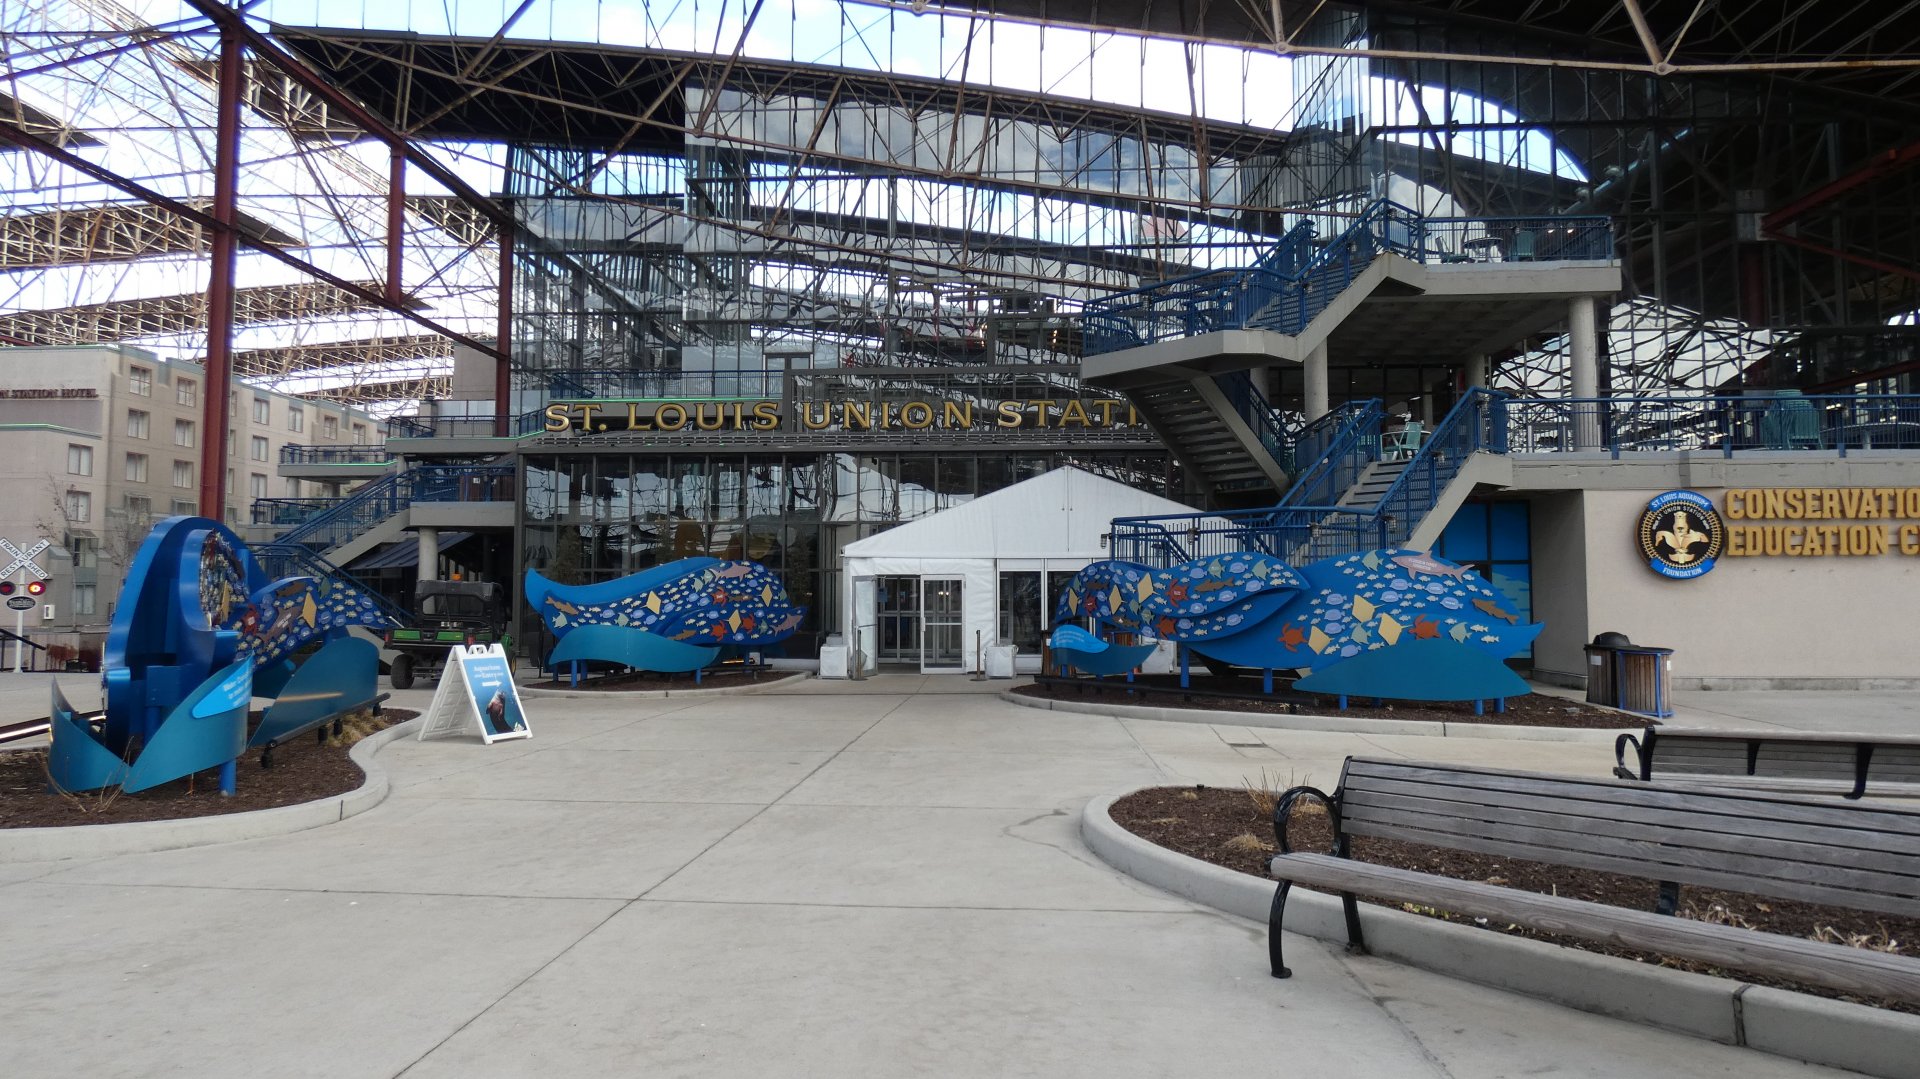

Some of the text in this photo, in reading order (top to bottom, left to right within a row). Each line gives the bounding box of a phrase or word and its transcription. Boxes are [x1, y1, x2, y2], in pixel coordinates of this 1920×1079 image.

[11, 389, 59, 399] STATION
[61, 388, 99, 398] HOTEL
[544, 402, 608, 432] ST.
[626, 402, 780, 431] LOUIS
[801, 400, 974, 430] UNION
[1661, 493, 1678, 503] LOUIS
[1678, 492, 1709, 508] AQUARIUM
[1726, 488, 1920, 520] CONSERVATIO
[1663, 505, 1681, 515] UNION
[1682, 505, 1705, 522] STATION
[0, 540, 20, 557] TRAIN
[1727, 524, 1920, 556] EDUCATION C
[0, 541, 46, 577] RESTAURANT
[27, 562, 46, 578] SHED
[1662, 567, 1702, 577] FOUNDATION
